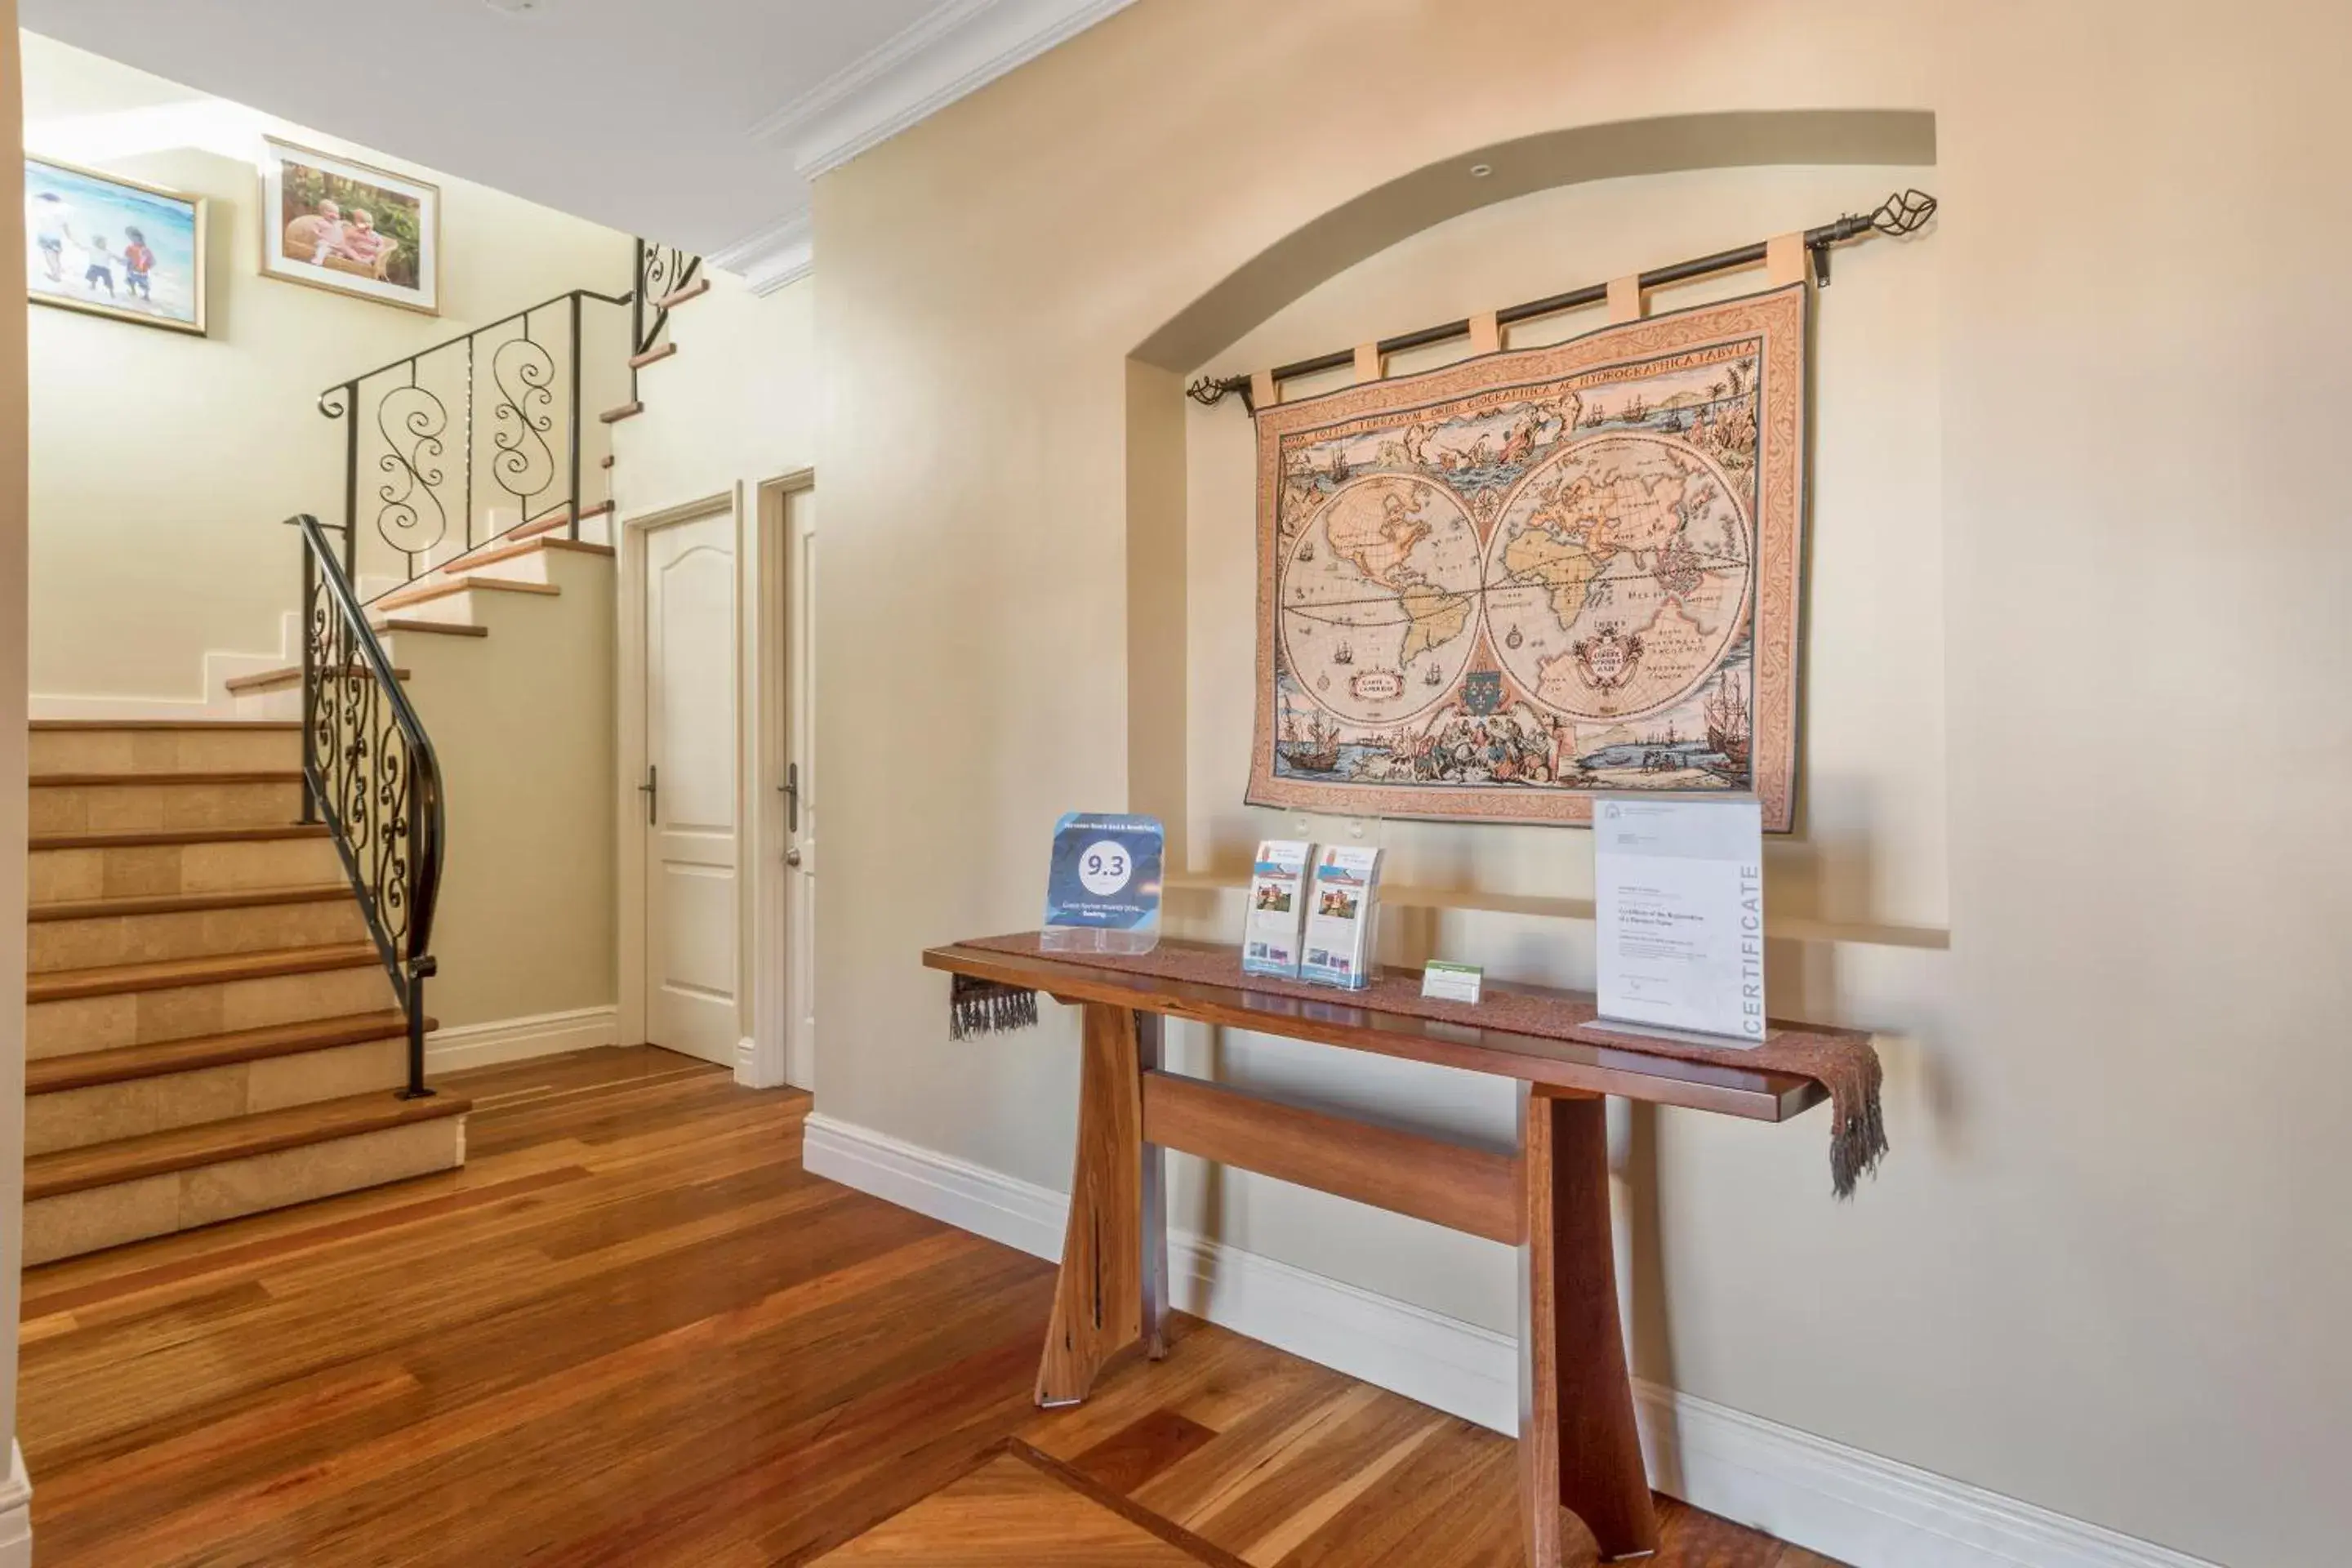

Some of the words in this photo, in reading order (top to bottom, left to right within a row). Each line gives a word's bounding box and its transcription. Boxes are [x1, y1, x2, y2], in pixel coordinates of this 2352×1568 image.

[1699, 341, 1756, 363] TABVLA
[1088, 855, 1124, 877] 9.3
[1741, 866, 1762, 1034] CERTIFICATE
